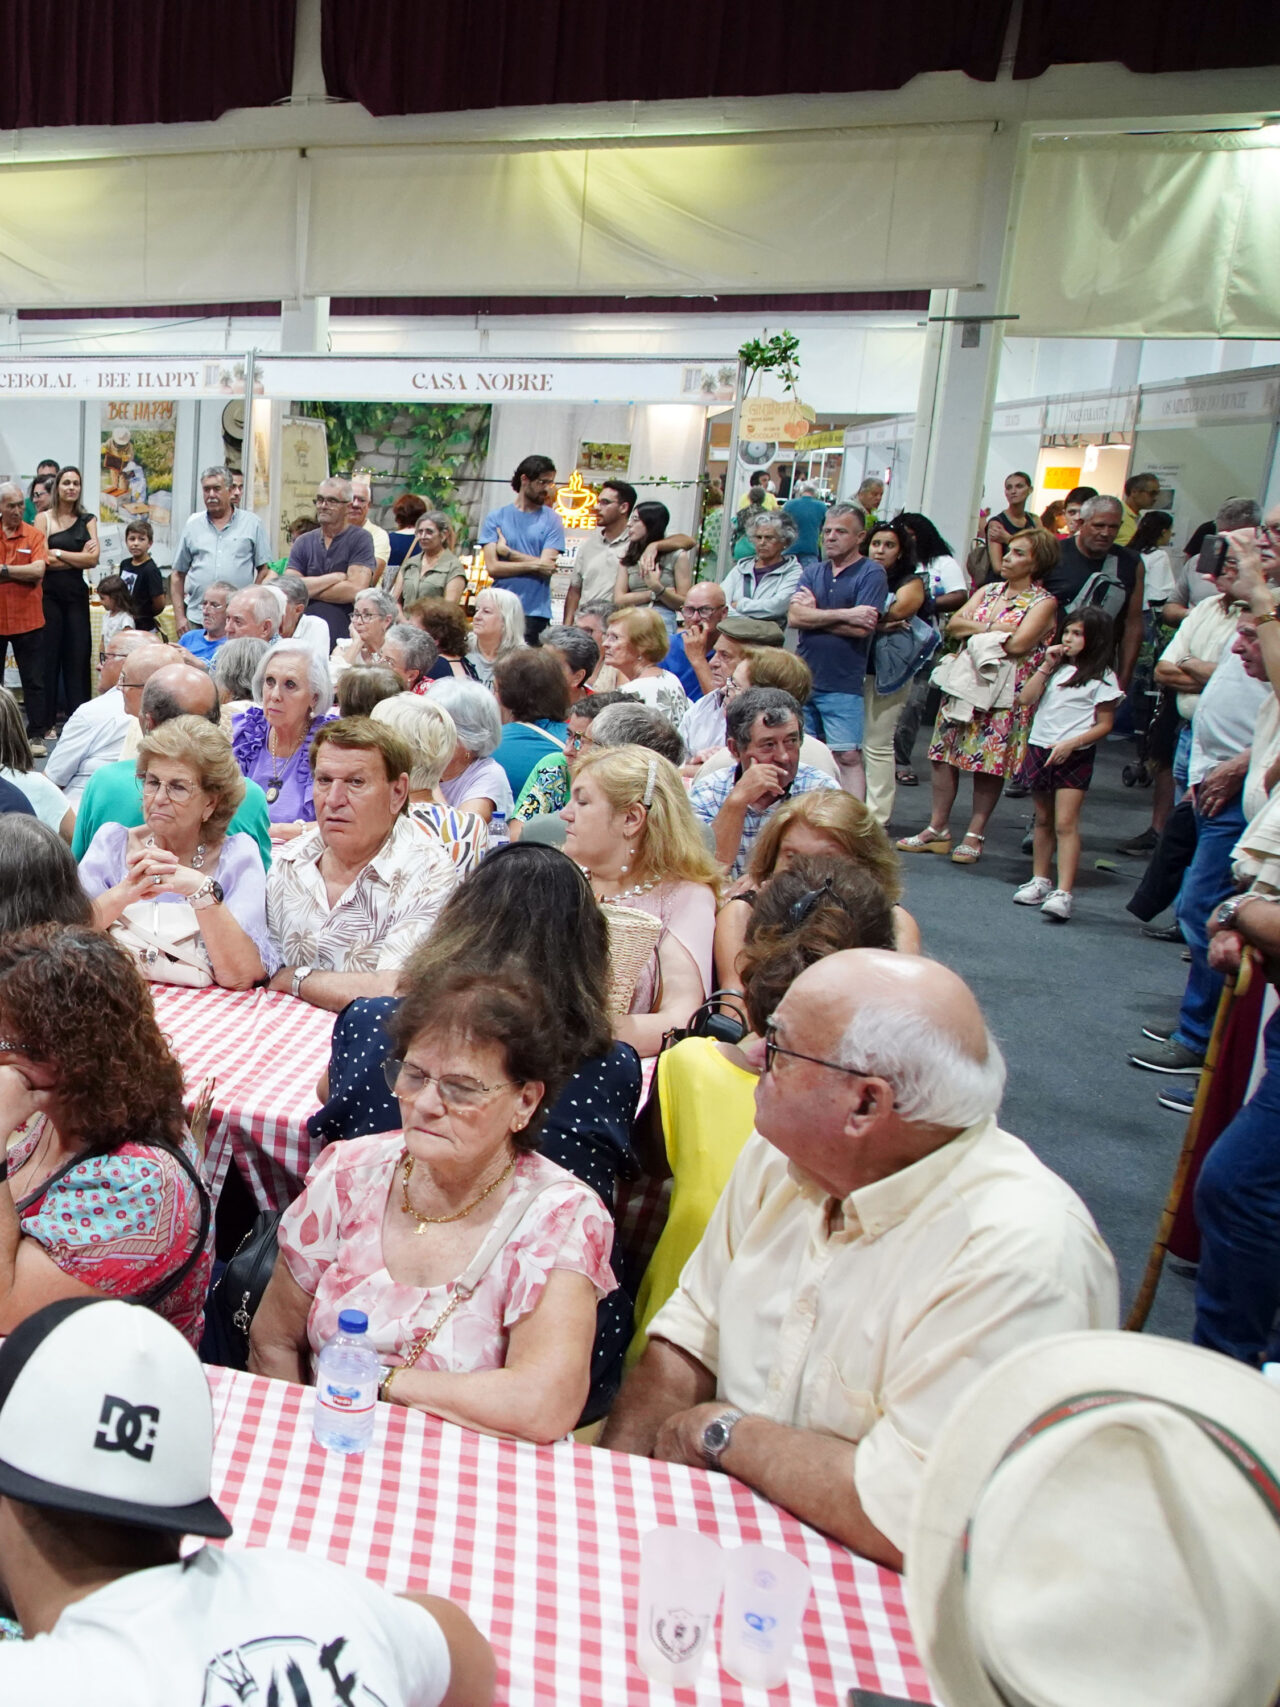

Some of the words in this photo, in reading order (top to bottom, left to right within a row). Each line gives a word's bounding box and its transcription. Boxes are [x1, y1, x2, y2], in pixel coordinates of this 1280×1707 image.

[97, 372, 131, 388] BEE
[137, 371, 199, 388] HAPPY
[411, 372, 467, 391] CASA
[476, 373, 554, 392] NOBRE
[108, 401, 128, 420] BEE
[133, 401, 175, 421] HAPPY
[93, 1394, 160, 1462] DC
